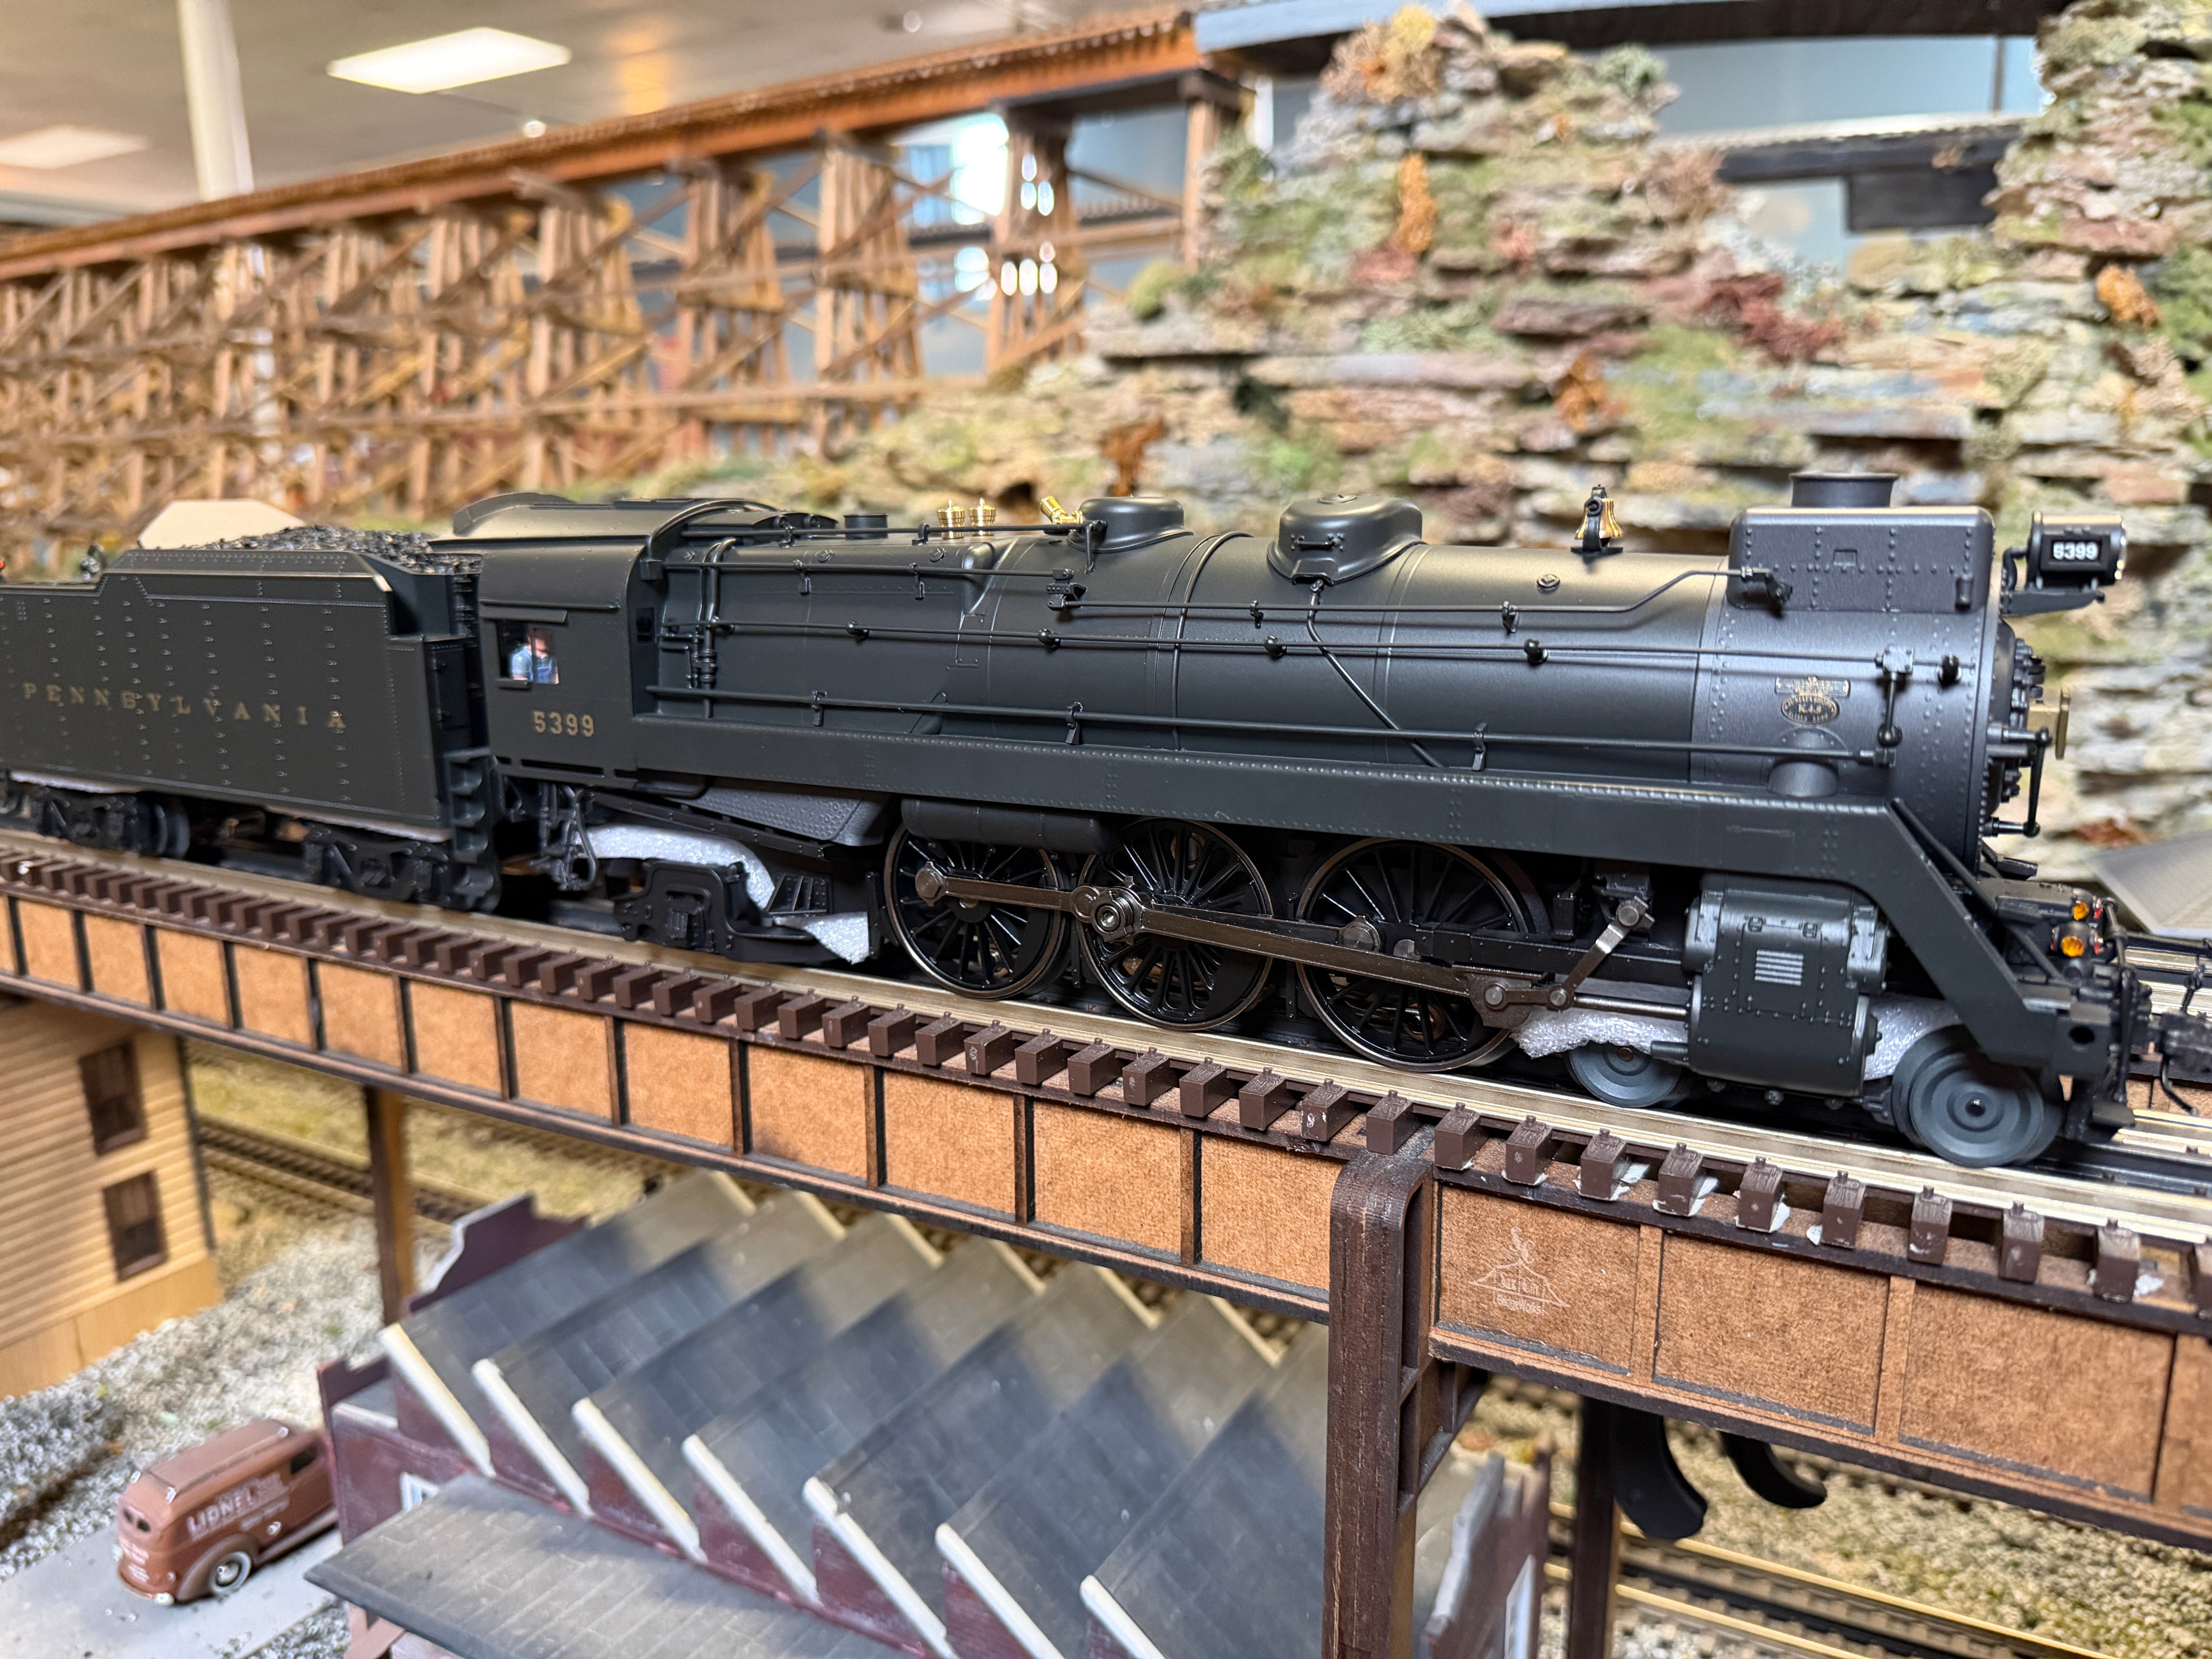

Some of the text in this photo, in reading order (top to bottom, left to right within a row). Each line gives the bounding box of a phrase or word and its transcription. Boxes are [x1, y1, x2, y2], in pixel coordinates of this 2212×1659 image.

[2053, 542, 2098, 560] 5399
[23, 682, 345, 728] PENNSYLVANIA
[534, 711, 594, 737] 5399
[186, 1486, 255, 1533] LIONEL
